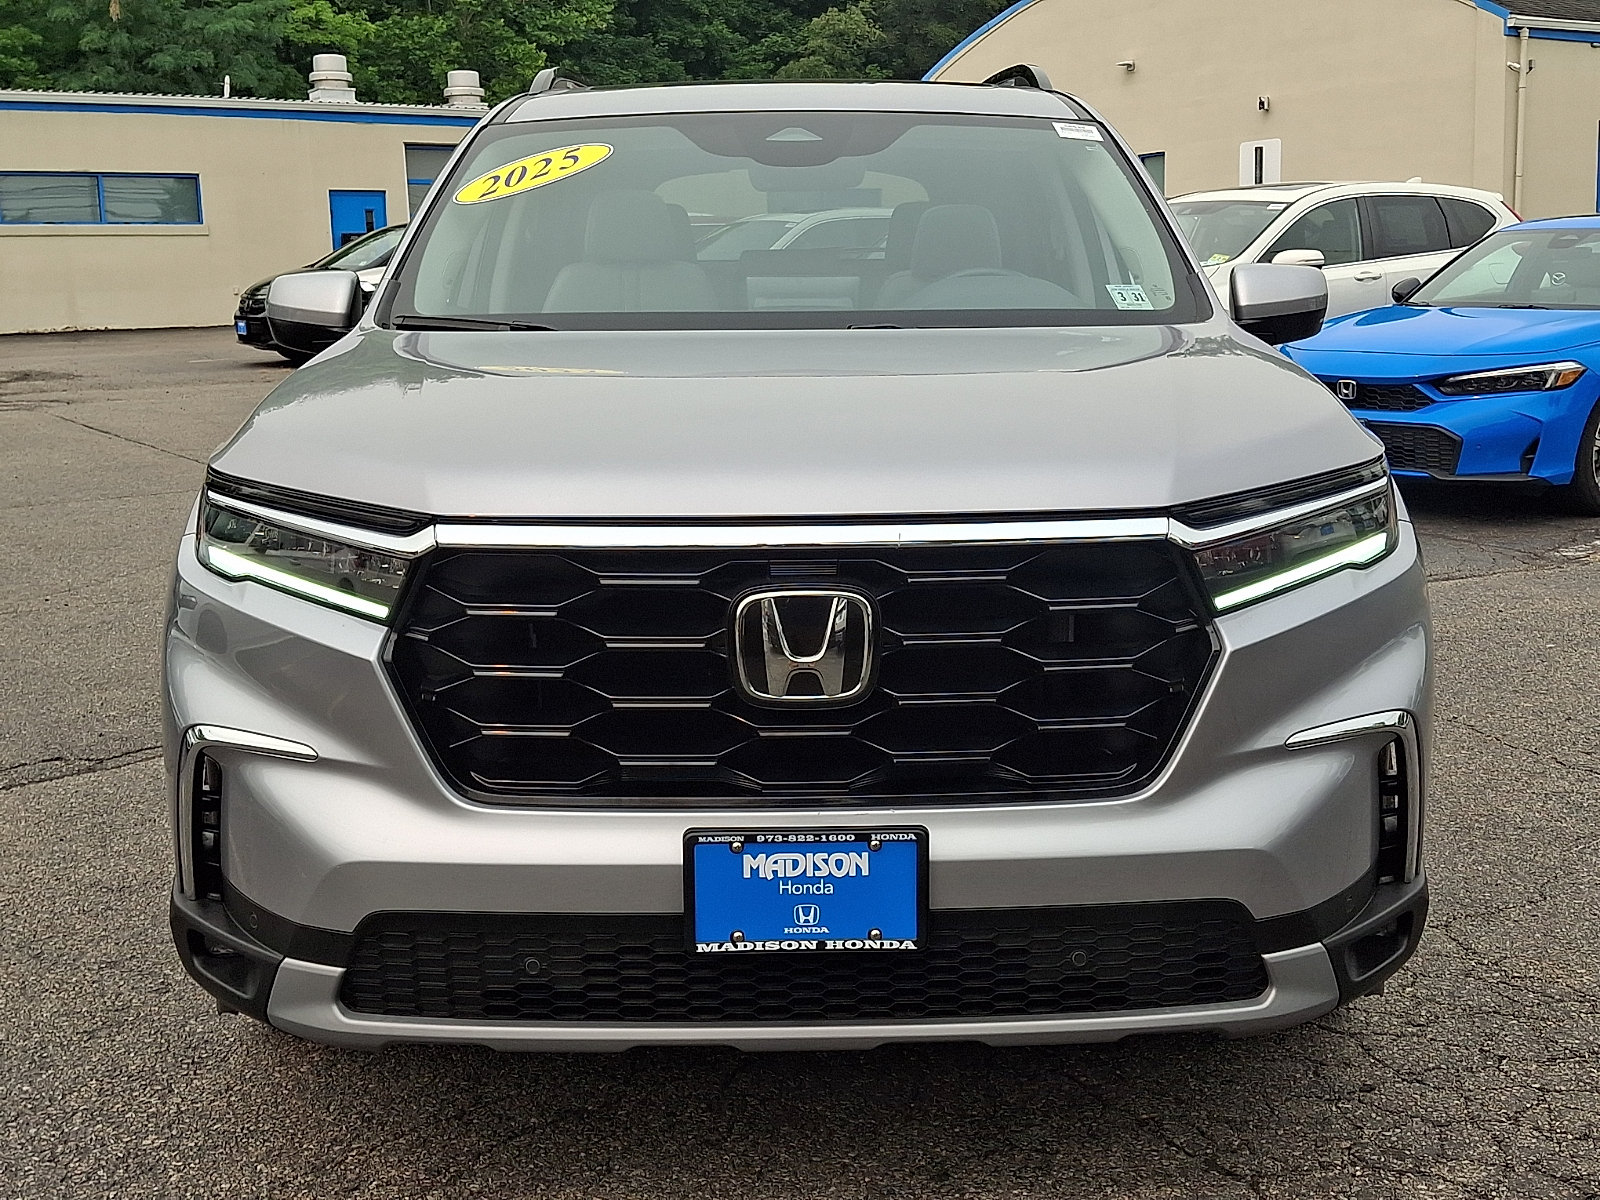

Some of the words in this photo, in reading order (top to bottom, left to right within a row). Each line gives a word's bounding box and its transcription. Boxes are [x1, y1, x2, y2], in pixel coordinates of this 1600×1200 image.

[478, 147, 580, 199] 2025
[1117, 292, 1127, 302] 3
[1131, 292, 1146, 302] 31
[756, 834, 855, 842] 973-822-1600
[871, 833, 917, 841] HONDA
[742, 852, 870, 881] MADISON
[779, 880, 834, 895] Honda
[695, 940, 818, 953] MADISON
[824, 939, 918, 950] HONDA
